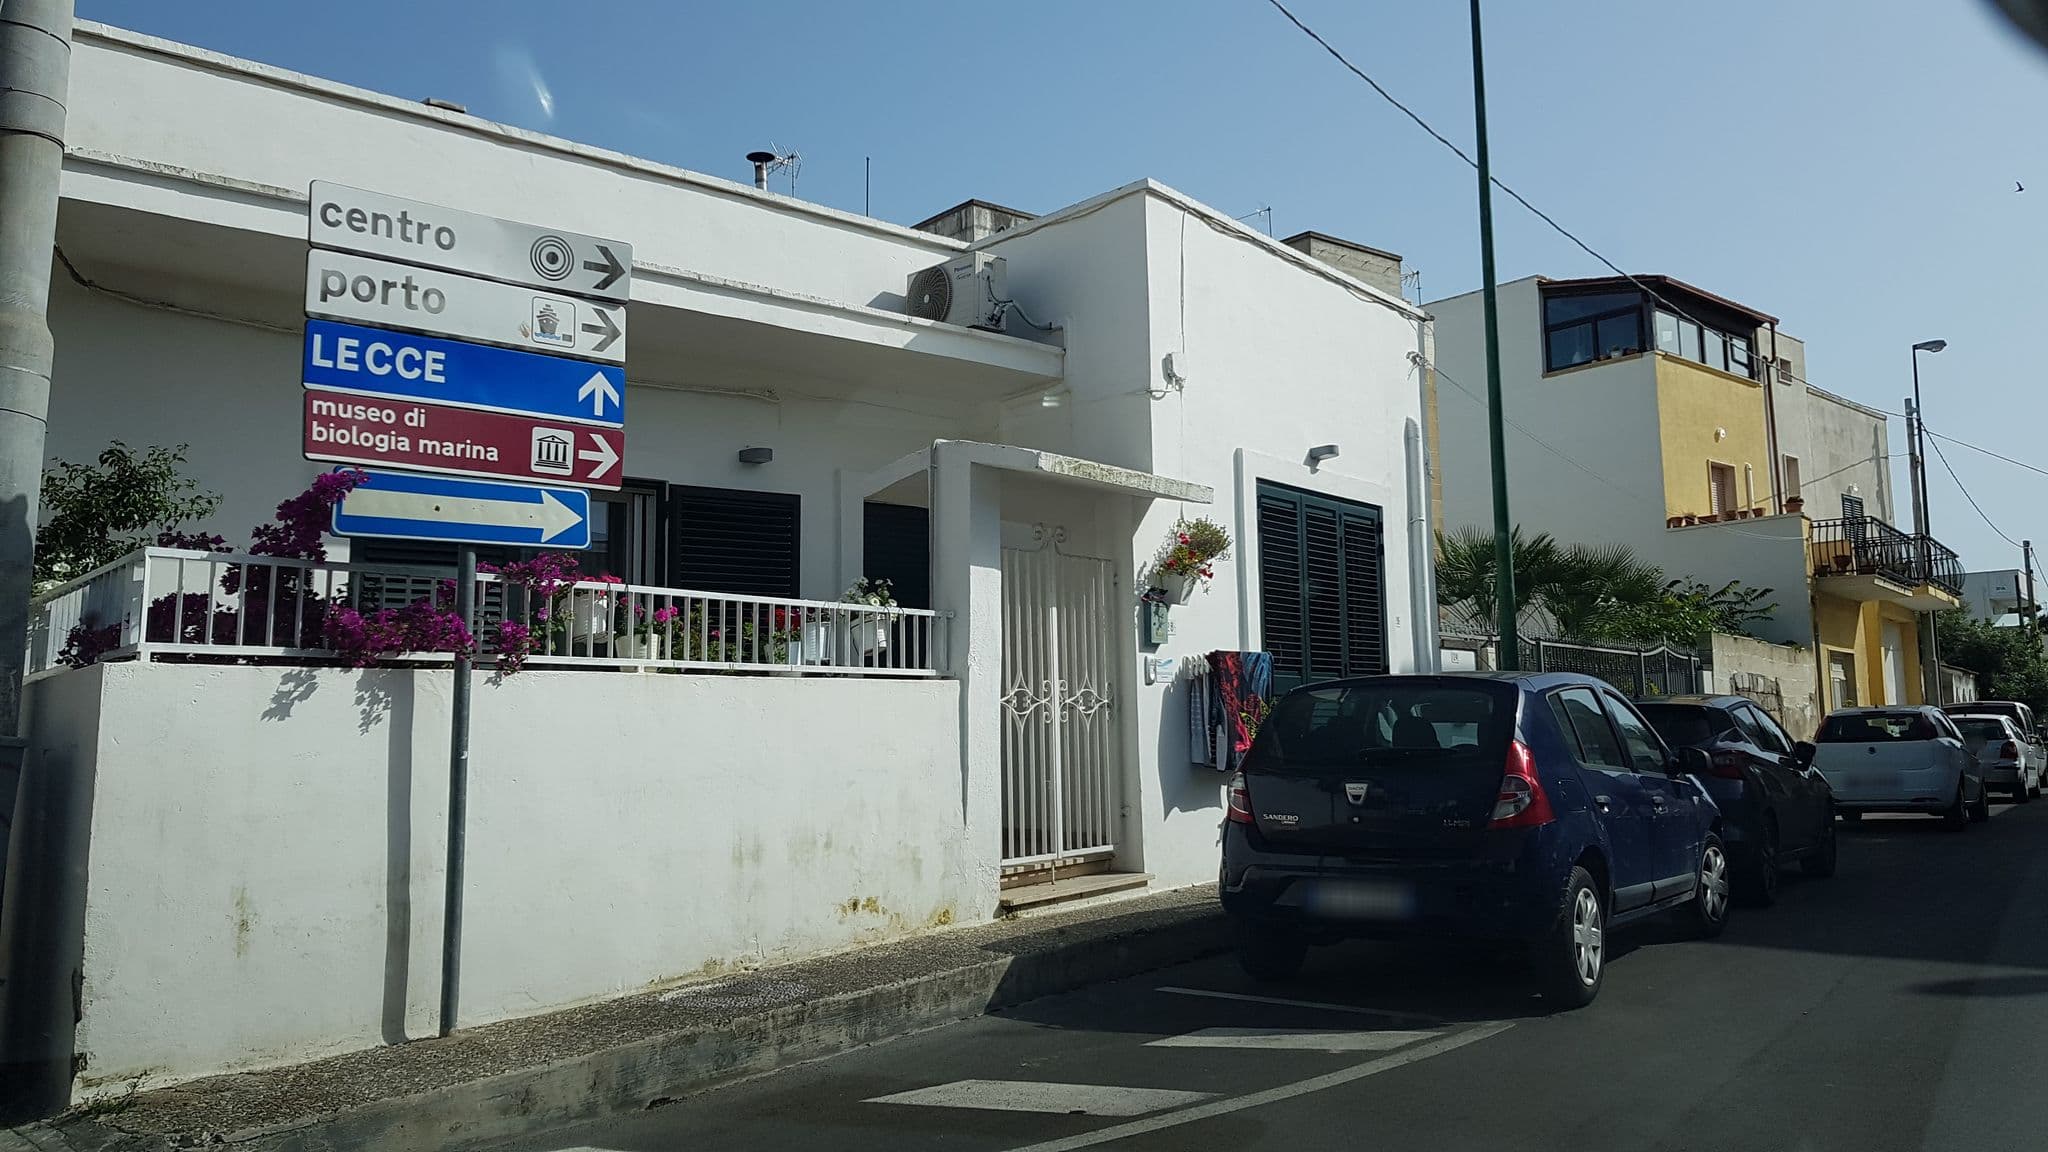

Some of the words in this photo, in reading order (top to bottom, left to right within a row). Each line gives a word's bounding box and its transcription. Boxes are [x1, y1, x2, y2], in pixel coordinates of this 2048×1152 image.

[319, 202, 456, 251] centro
[319, 268, 446, 315] porto
[311, 333, 446, 384] LECCE
[312, 399, 396, 424] museo
[403, 407, 426, 428] di
[311, 420, 411, 453] biologia
[418, 438, 499, 462] marina
[1263, 813, 1299, 822] SANDERO
